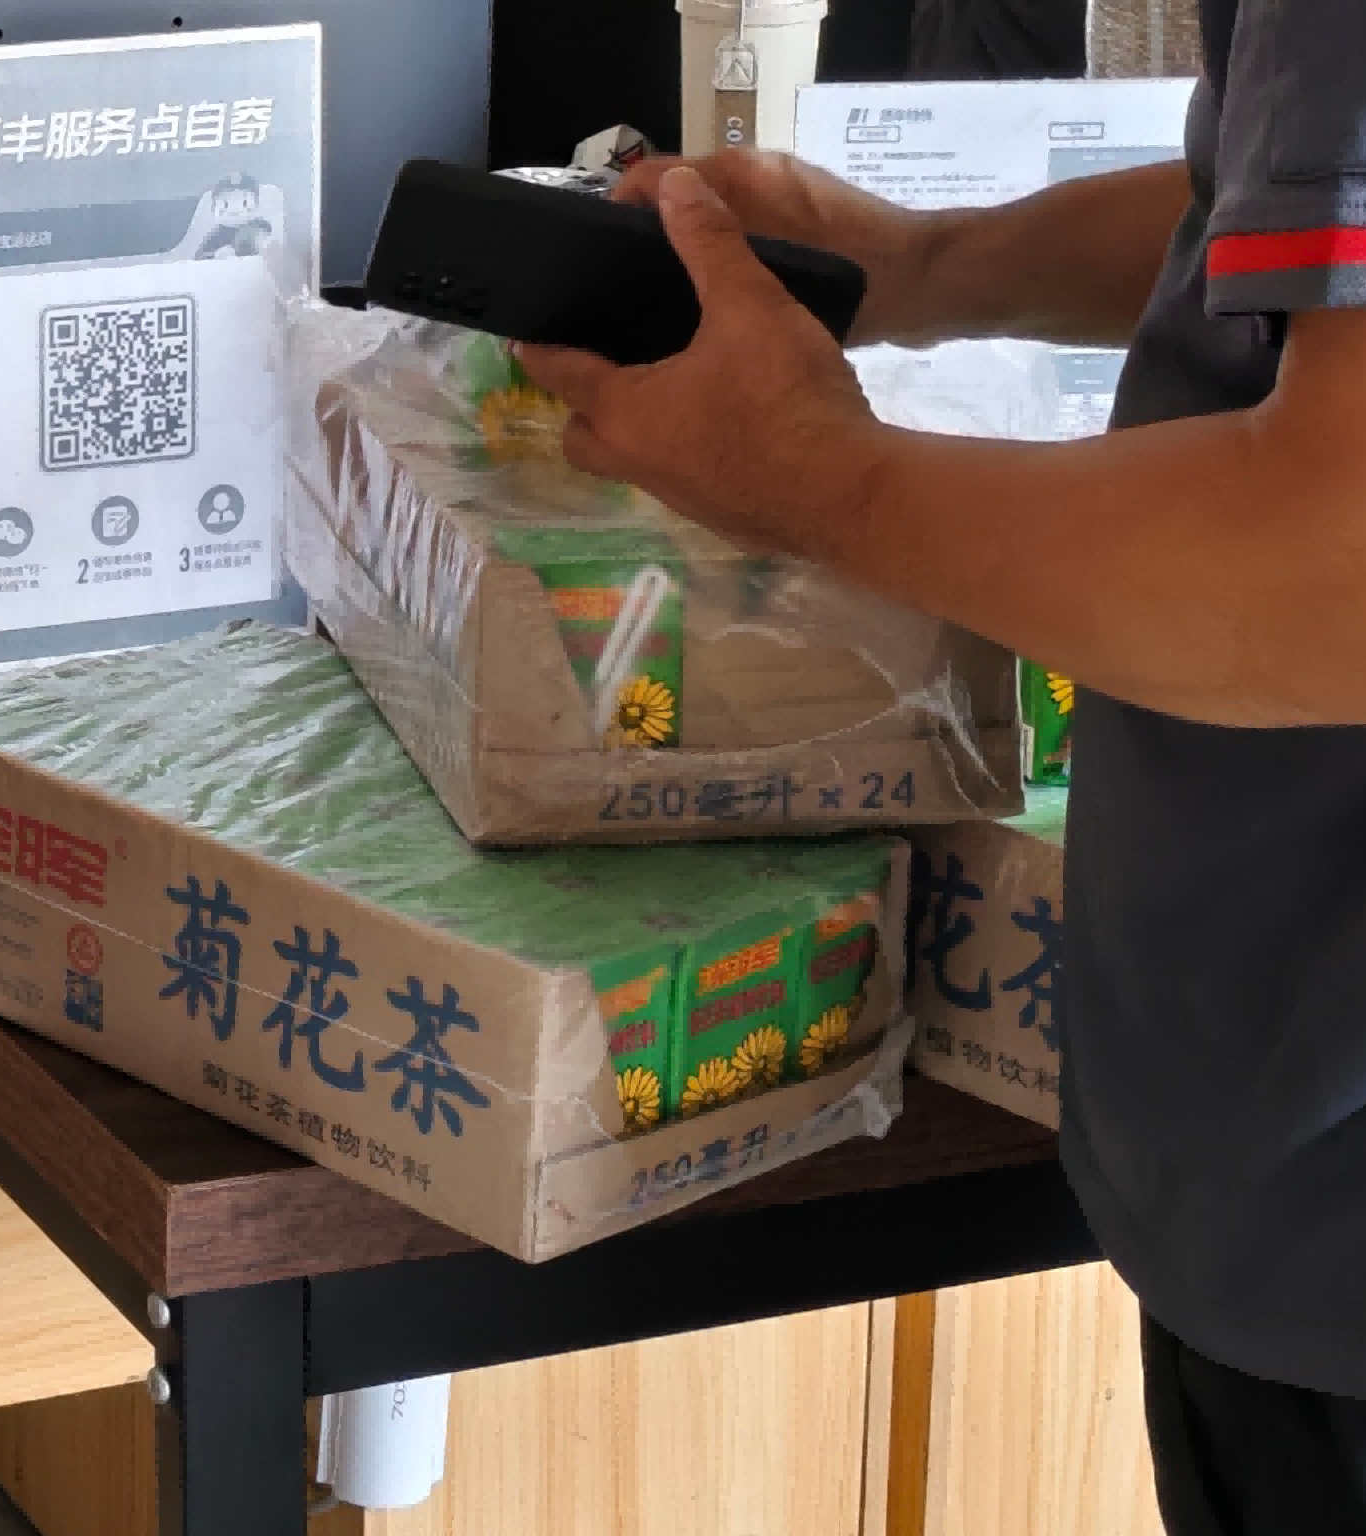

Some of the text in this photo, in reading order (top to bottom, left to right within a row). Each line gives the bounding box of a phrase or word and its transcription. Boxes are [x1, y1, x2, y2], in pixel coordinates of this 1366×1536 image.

[725, 115, 745, 148] CO
[158, 875, 492, 1139] 菊花茶
[202, 1060, 432, 1192] 菊花茶植物饮料
